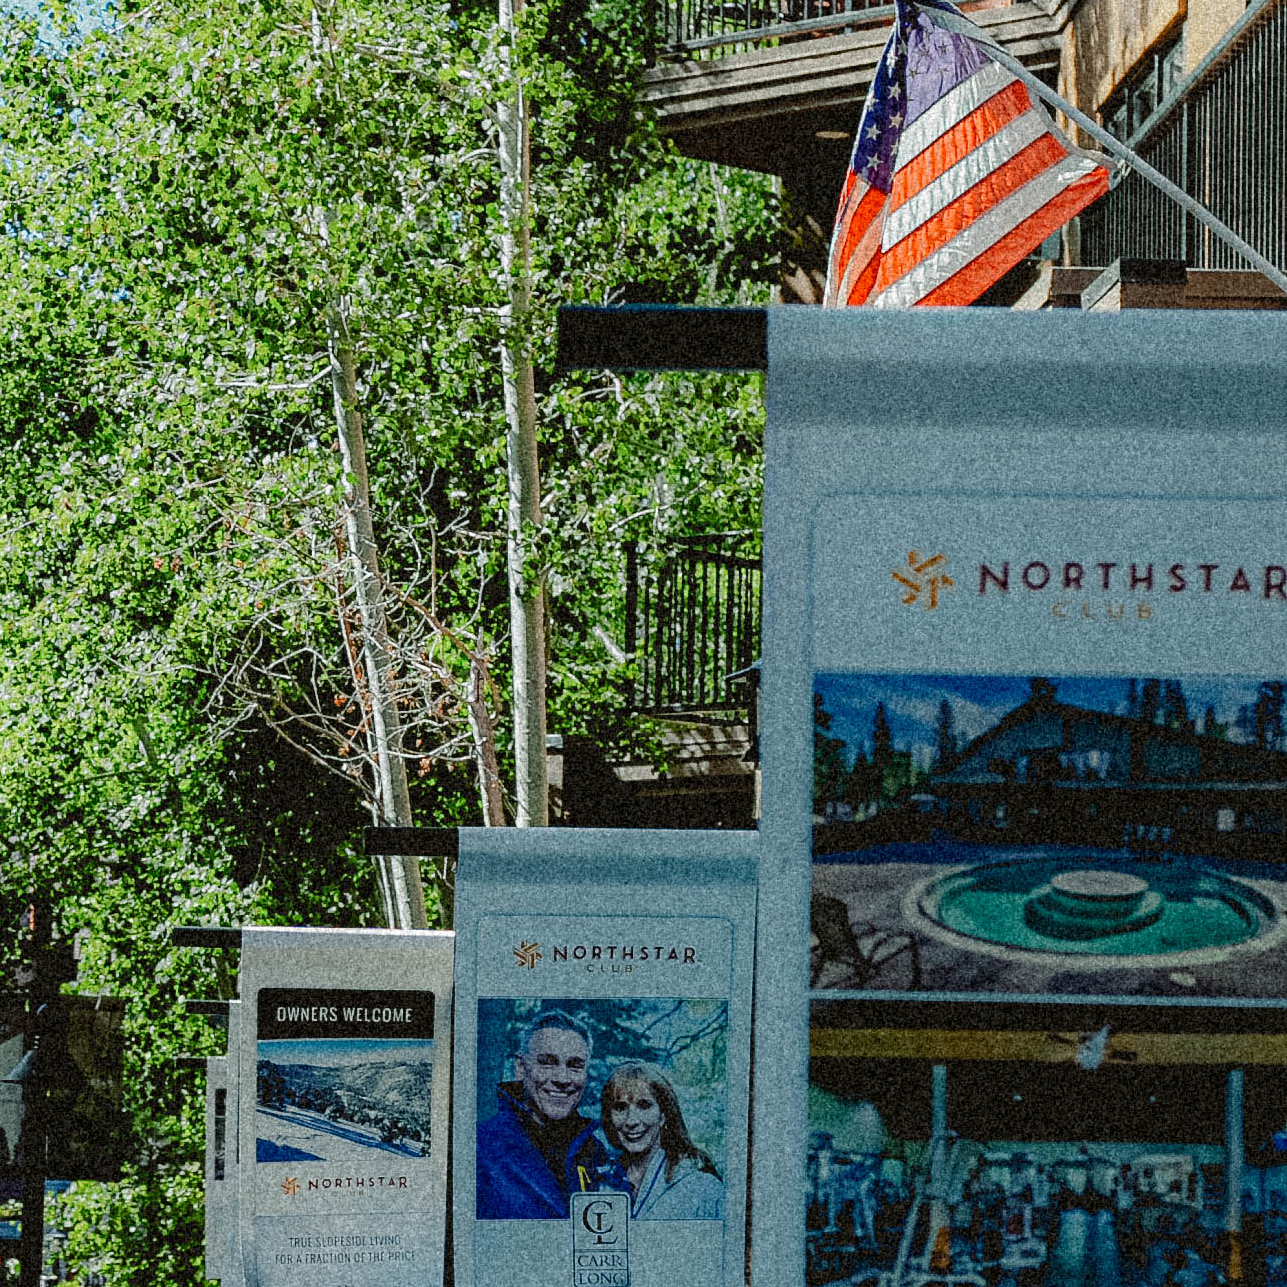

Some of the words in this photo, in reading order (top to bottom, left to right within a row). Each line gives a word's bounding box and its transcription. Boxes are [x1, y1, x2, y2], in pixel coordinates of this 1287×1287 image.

[978, 561, 1287, 600] NORTHSTAR
[1051, 601, 1153, 620] CLUB
[552, 945, 696, 964] NORTHSTAR
[586, 963, 633, 973] CLUB
[276, 1006, 338, 1022] OWNERS
[343, 1007, 413, 1023] WELCOME
[308, 1176, 408, 1191] NORTHSTAR
[289, 1236, 313, 1248] TRUE
[316, 1235, 366, 1248] SLOPESIDE
[370, 1234, 402, 1246] LIVING
[275, 1254, 294, 1265] FOR
[296, 1254, 303, 1265] A
[305, 1253, 351, 1265] FRACTION
[354, 1253, 366, 1264] OF
[368, 1252, 386, 1263] THE
[388, 1250, 416, 1263] PRICE
[577, 1254, 624, 1267] CARR
[578, 1272, 624, 1285] LONG
